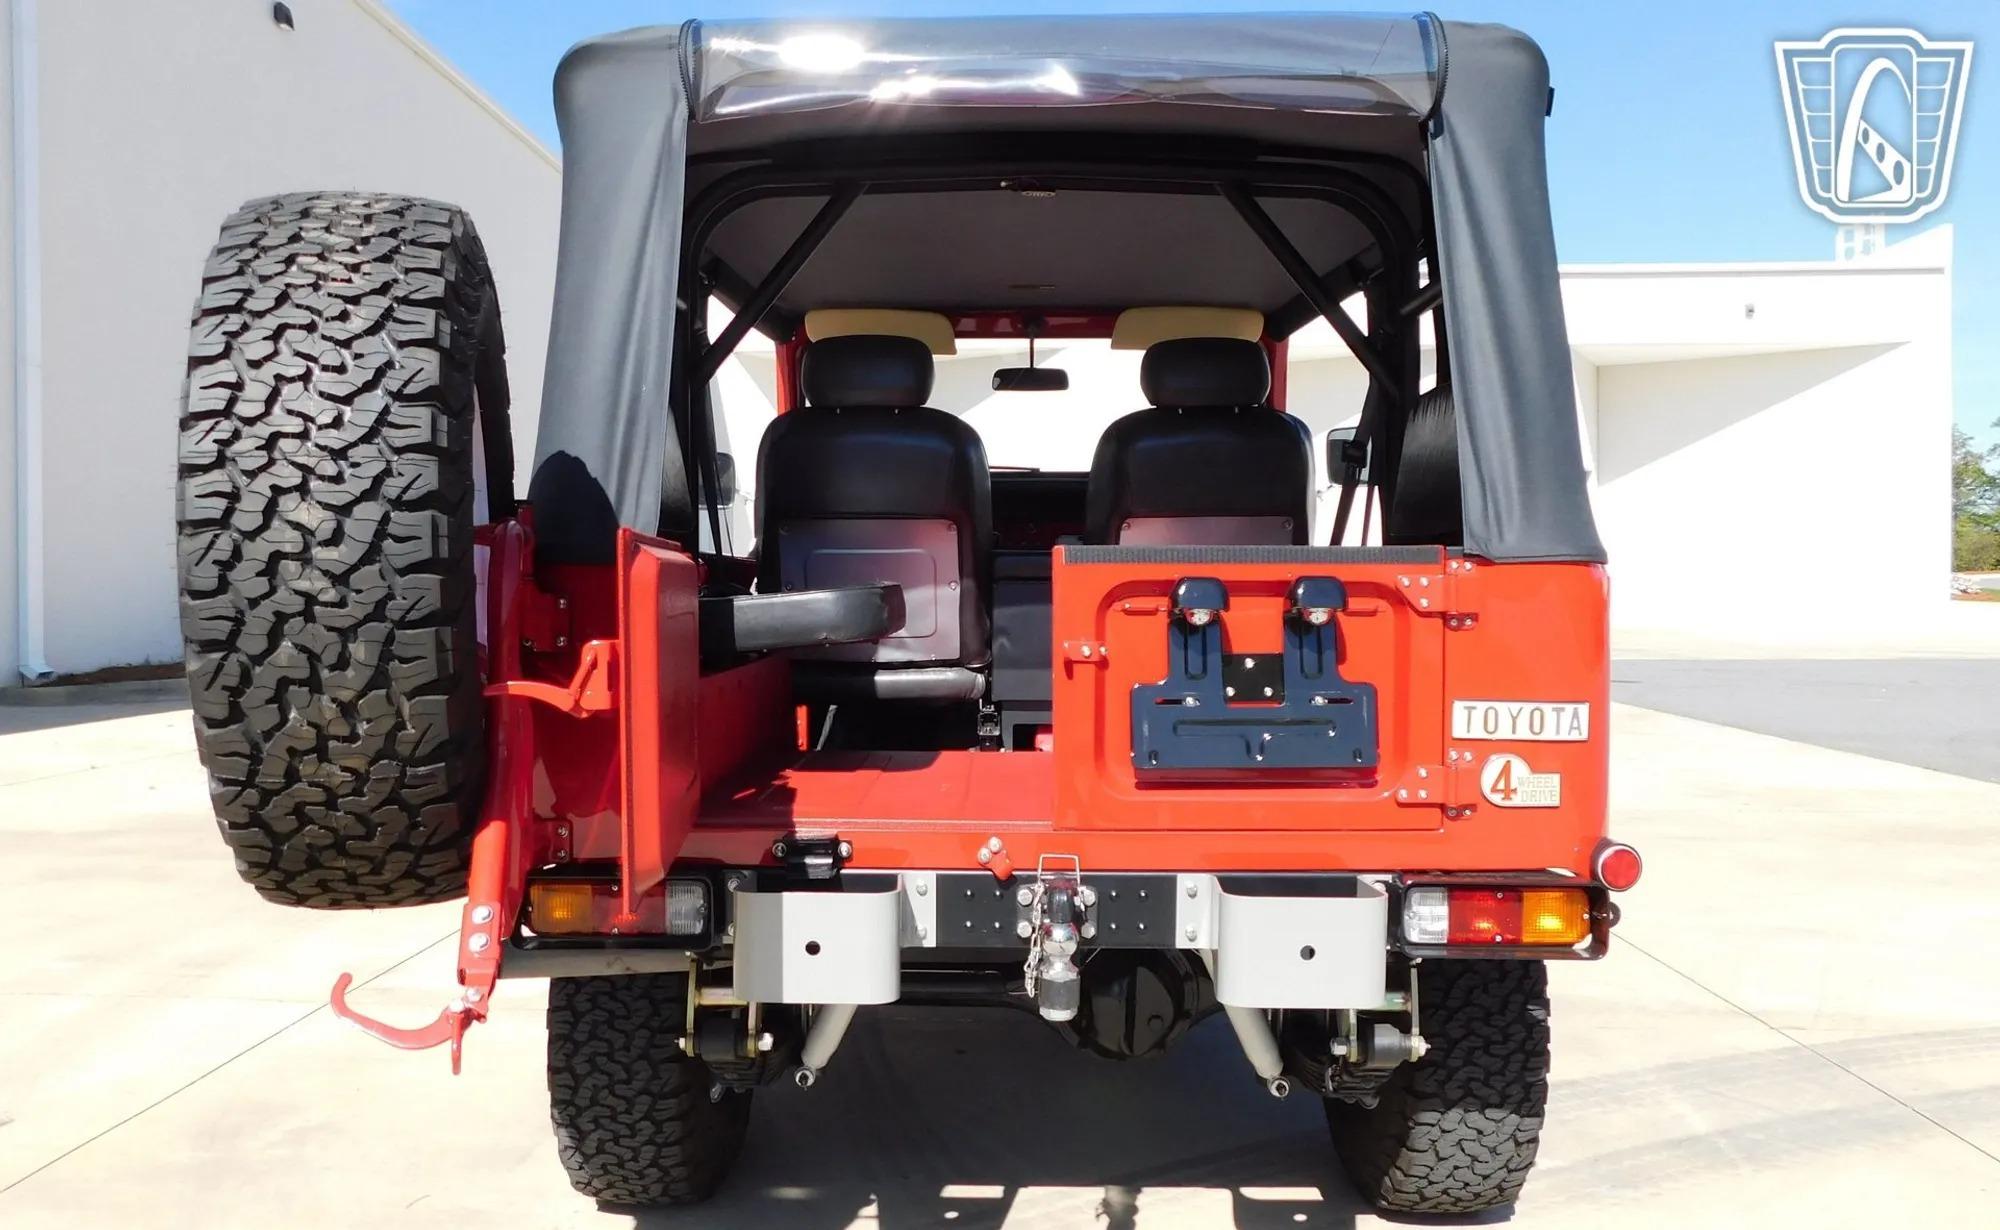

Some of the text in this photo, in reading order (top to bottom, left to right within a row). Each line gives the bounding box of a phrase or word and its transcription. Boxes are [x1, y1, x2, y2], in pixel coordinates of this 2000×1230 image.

[1463, 706, 1583, 736] TOYOTA
[1490, 760, 1518, 801] 4
[1517, 776, 1557, 789] WHEEL
[1520, 789, 1558, 803] DRIVE
